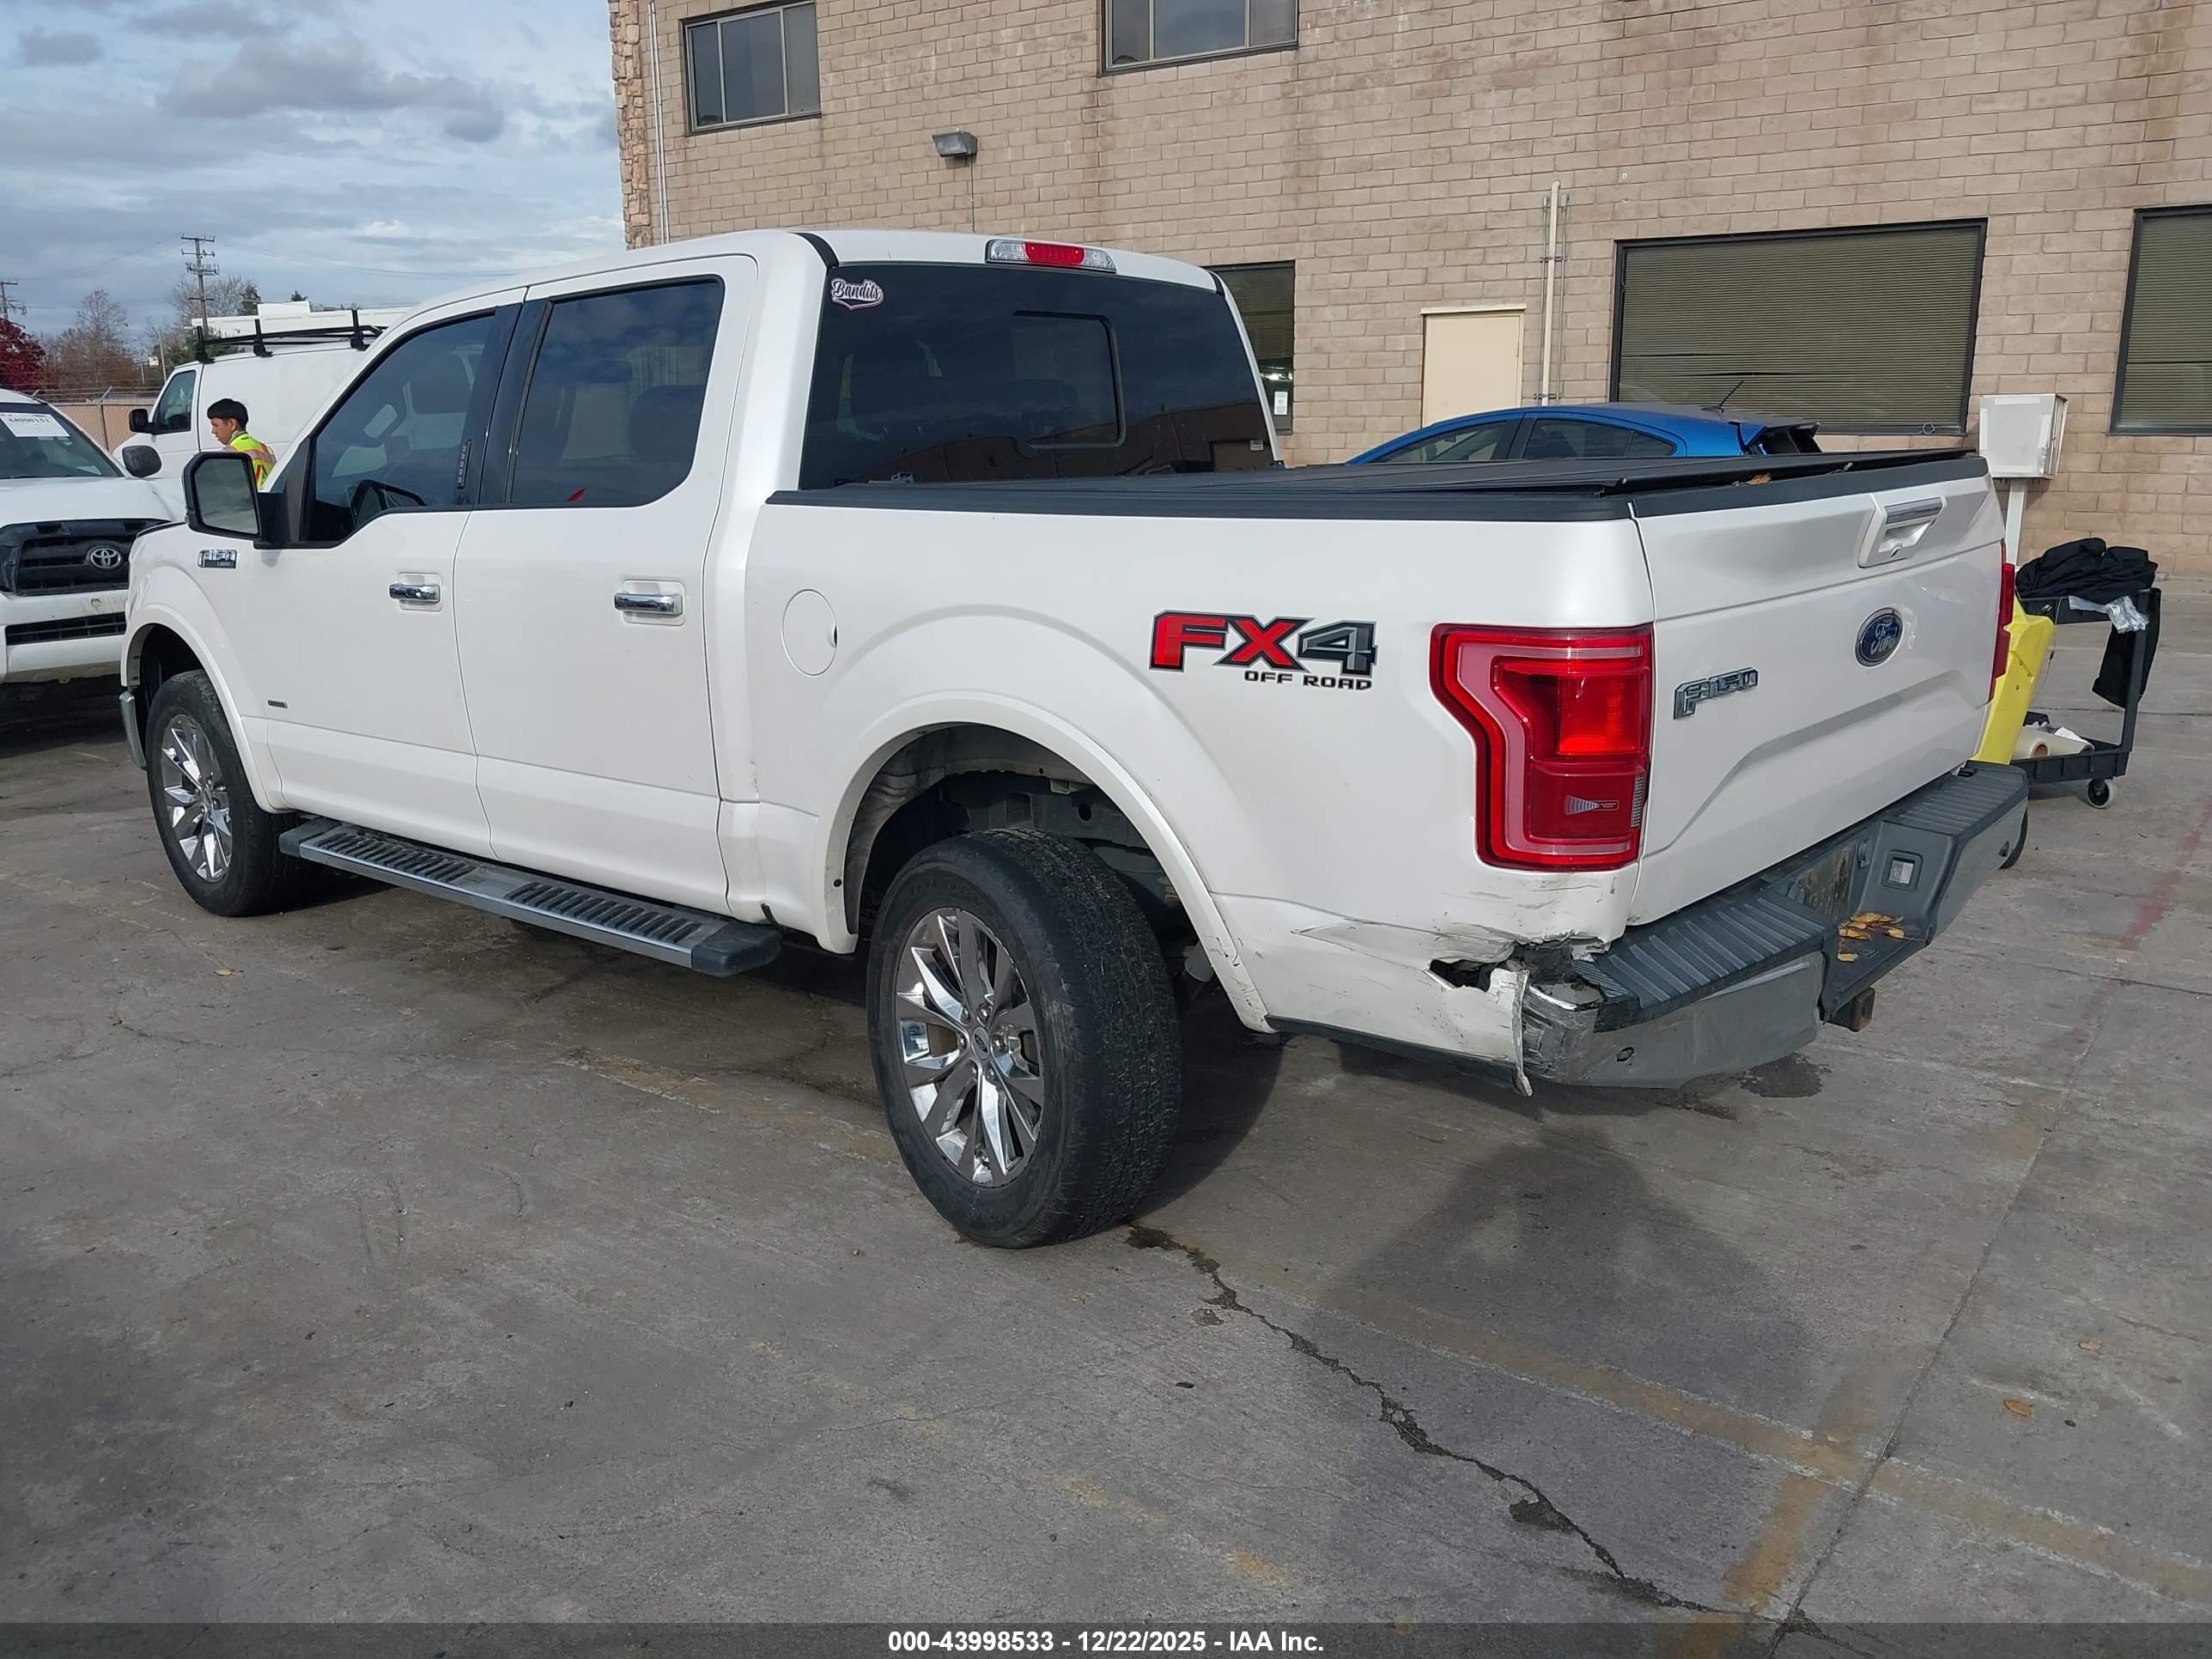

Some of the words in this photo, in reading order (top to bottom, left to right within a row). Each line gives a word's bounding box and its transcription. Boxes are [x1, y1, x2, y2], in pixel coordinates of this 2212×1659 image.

[832, 280, 878, 300] Bandits
[1149, 610, 1378, 678] FX4
[1869, 620, 1898, 655] Ford
[1244, 671, 1293, 684] OFF
[1303, 675, 1372, 690] ROAD
